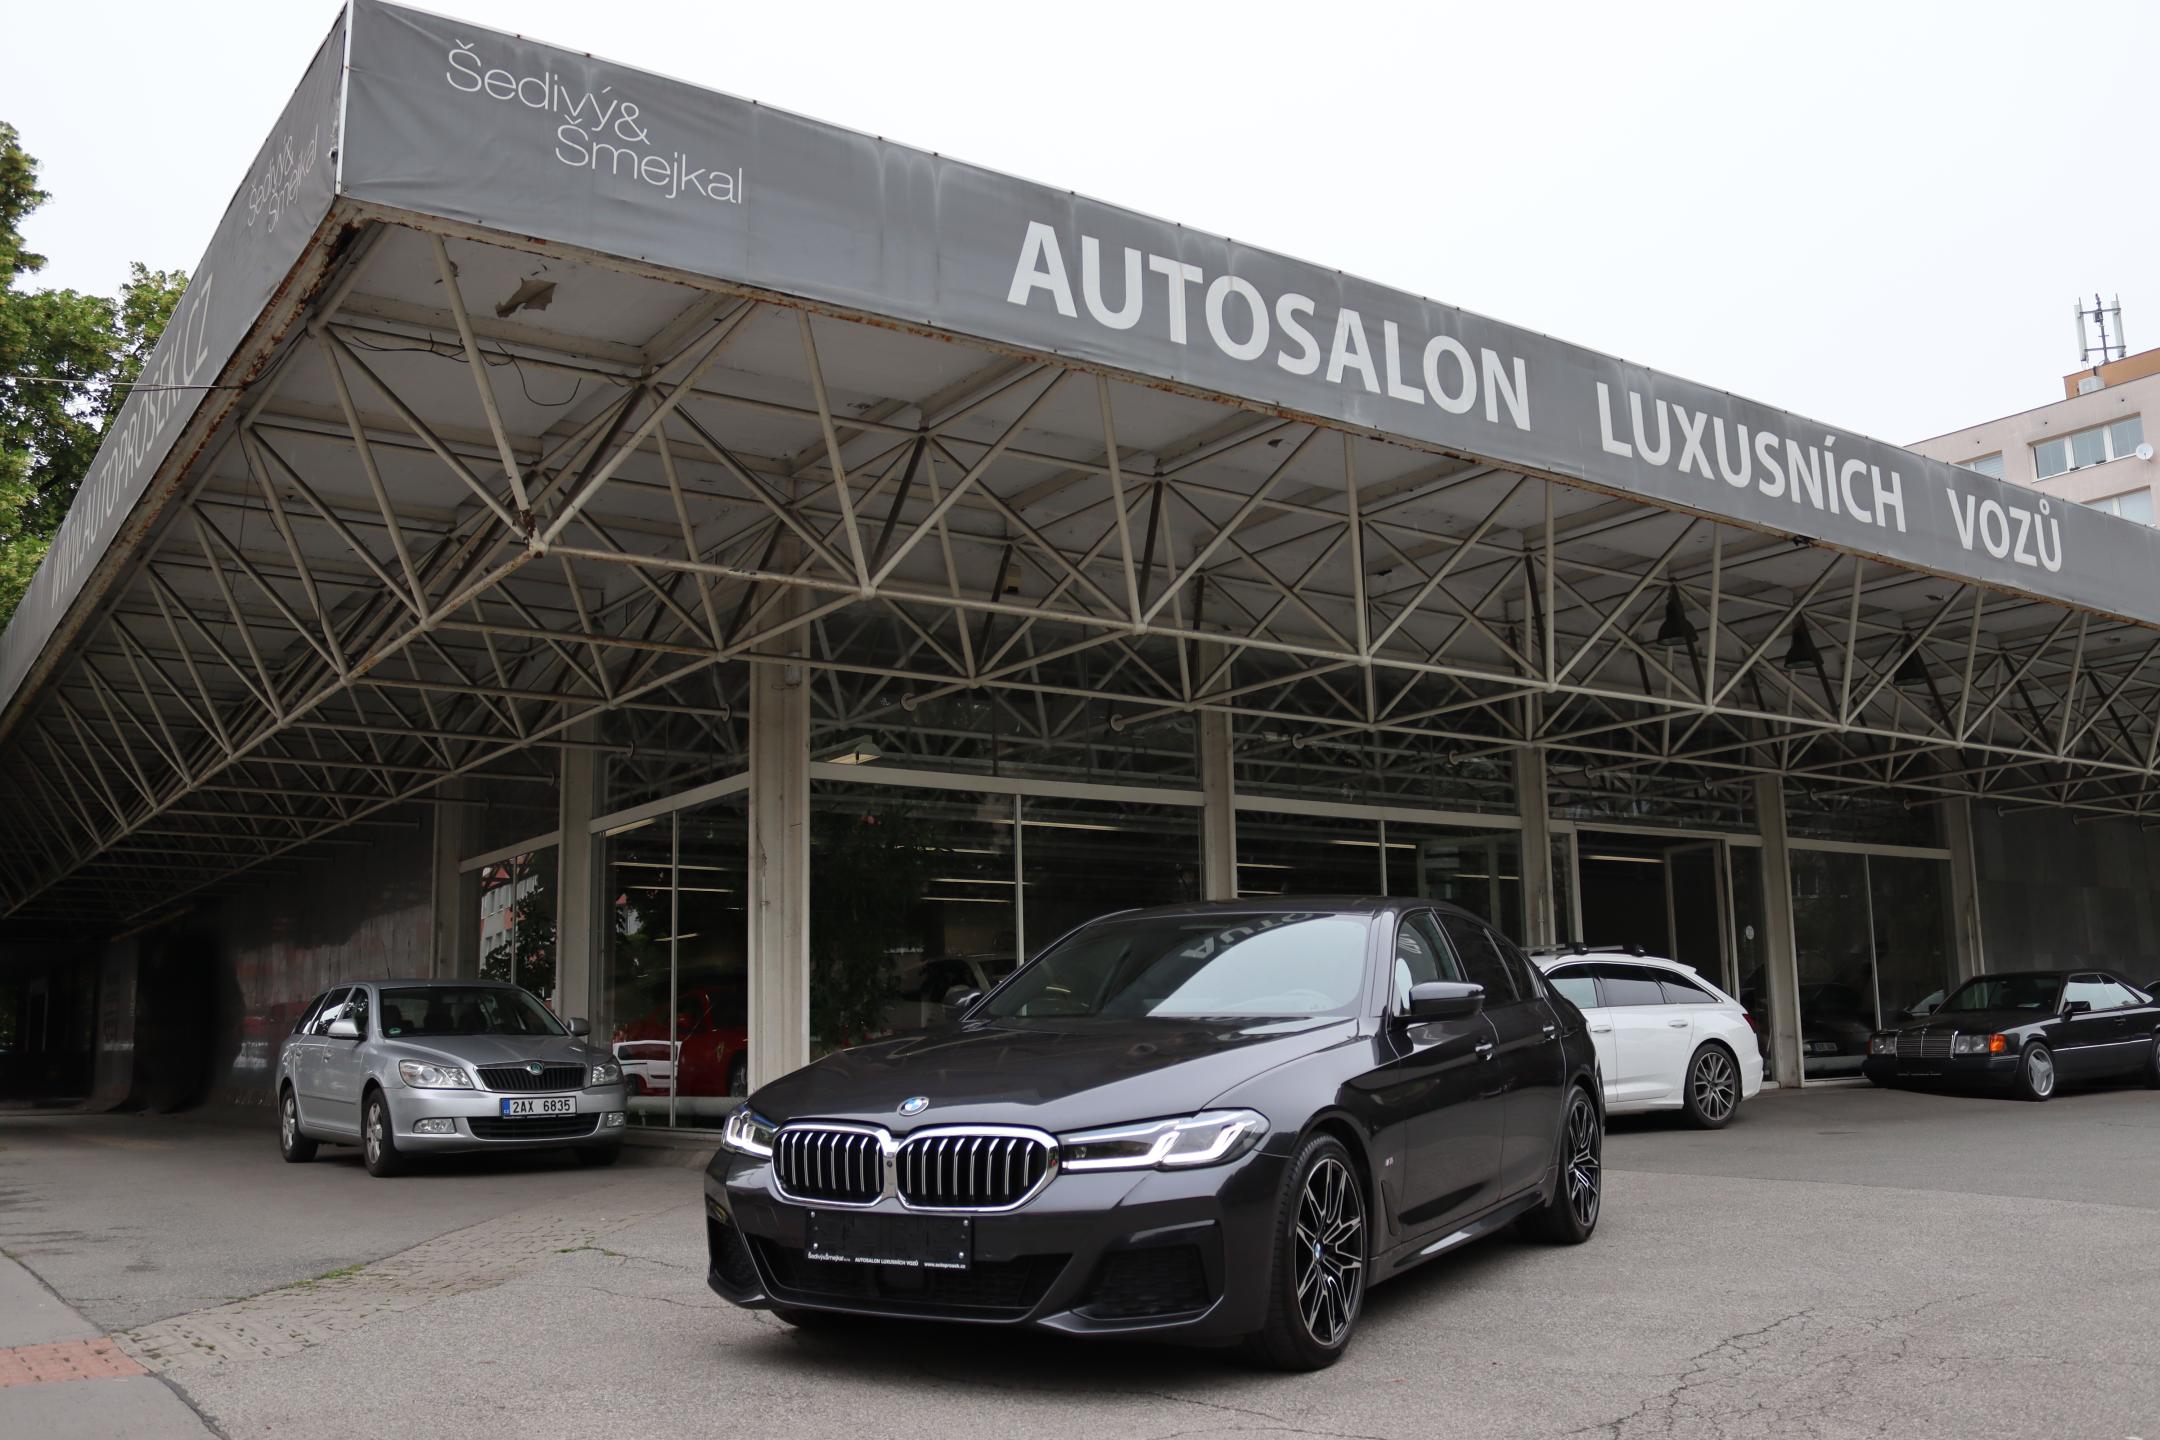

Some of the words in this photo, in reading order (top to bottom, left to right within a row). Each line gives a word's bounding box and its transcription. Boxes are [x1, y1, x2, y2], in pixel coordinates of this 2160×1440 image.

[446, 38, 651, 145] Šedivý&
[555, 114, 743, 204] Šmejkal
[1006, 219, 1532, 432] AUTOSALON
[1595, 381, 1907, 533] LUXUSNÍCH
[1946, 487, 2063, 573] VOZŮ
[512, 1100, 535, 1114] 2AX
[543, 1099, 571, 1112] 6835
